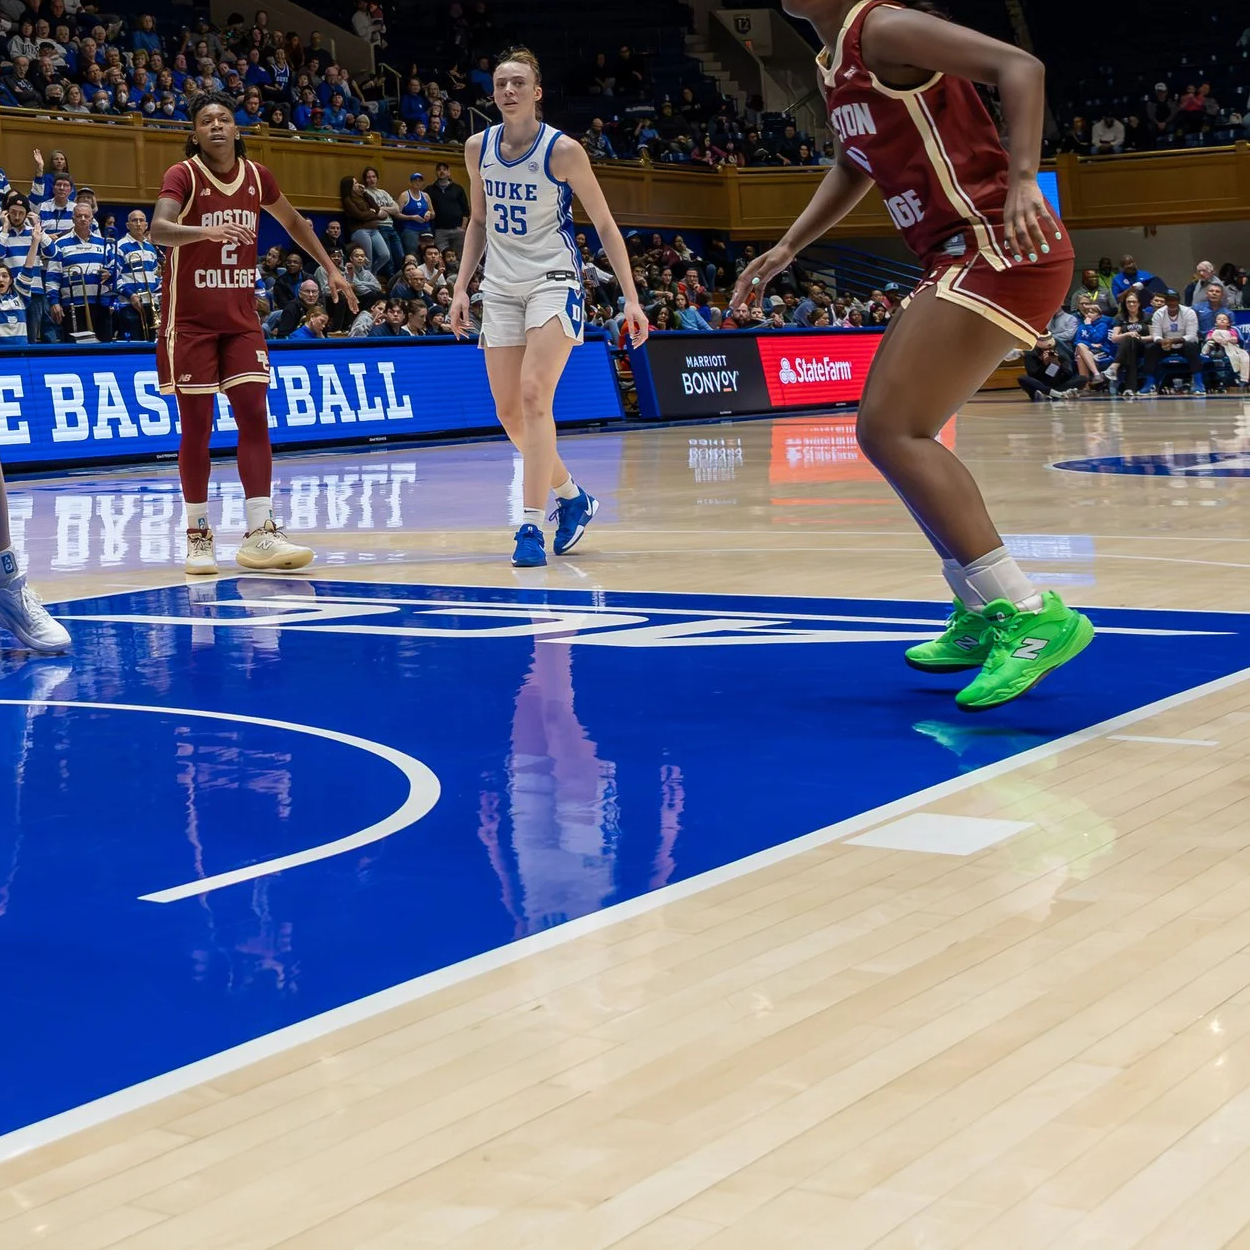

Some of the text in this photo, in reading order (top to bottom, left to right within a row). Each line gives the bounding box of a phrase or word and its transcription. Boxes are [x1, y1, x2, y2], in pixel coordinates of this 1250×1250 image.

[485, 179, 537, 201] DUKE
[493, 203, 528, 236] 35
[221, 237, 238, 265] 2
[194, 268, 255, 289] COLLEGE
[685, 355, 727, 368] MARRIOTT
[795, 357, 851, 382] StateFarm
